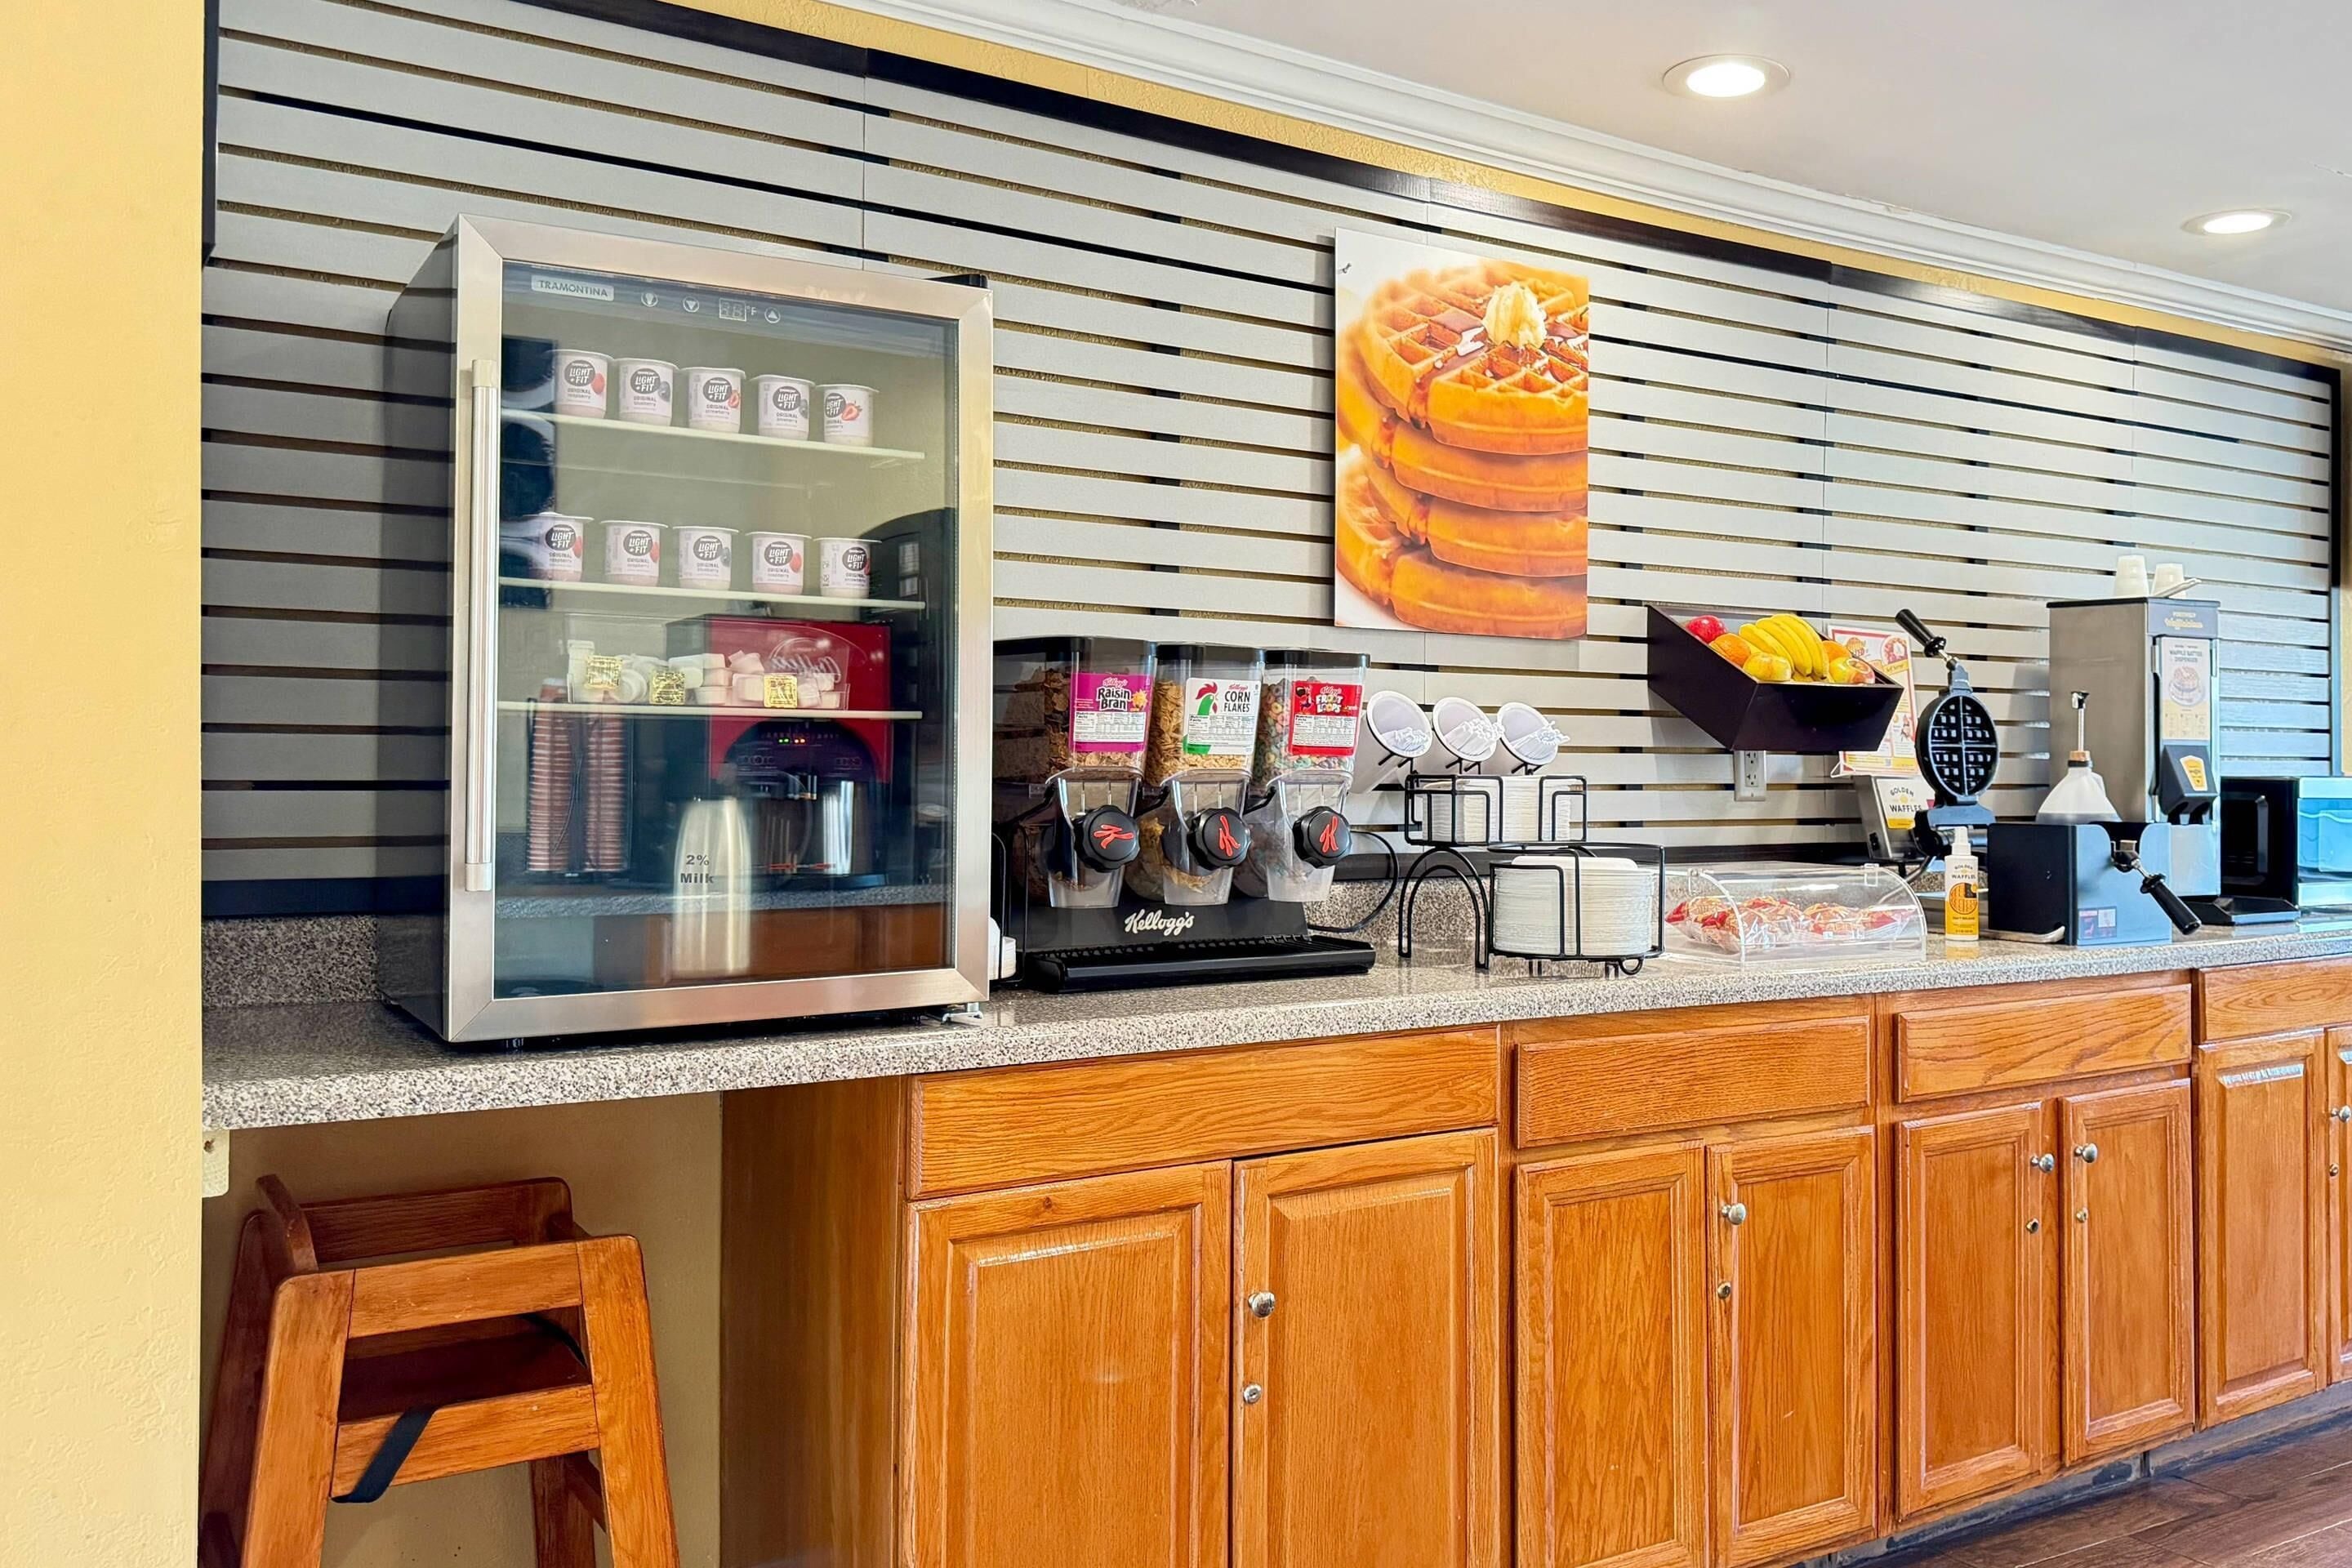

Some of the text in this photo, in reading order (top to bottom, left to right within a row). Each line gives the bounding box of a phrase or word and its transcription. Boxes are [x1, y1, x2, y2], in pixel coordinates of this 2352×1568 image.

[537, 279, 608, 297] TRAMONTINA
[569, 368, 593, 376] LIGHT
[635, 376, 658, 385] LIGHT
[708, 385, 730, 394] LIGHT
[777, 394, 799, 402] LIGHT
[551, 532, 574, 541] LIGHT
[629, 537, 652, 546] LIGHT
[698, 542, 720, 551] LIGHT
[768, 548, 791, 557] LIGHT
[847, 554, 866, 562] LIGHT
[1097, 688, 1130, 700] Raisin
[1224, 691, 1250, 702] CORN
[1101, 698, 1126, 710] Bran
[1223, 702, 1250, 713] FLAKES
[1316, 703, 1342, 713] LOOPS
[1890, 786, 1914, 797] GOLDEN
[1889, 804, 1922, 813] WAFFLES
[686, 854, 710, 866] 2%
[680, 873, 715, 884] Milk
[1125, 908, 1195, 936] Kellogg's
